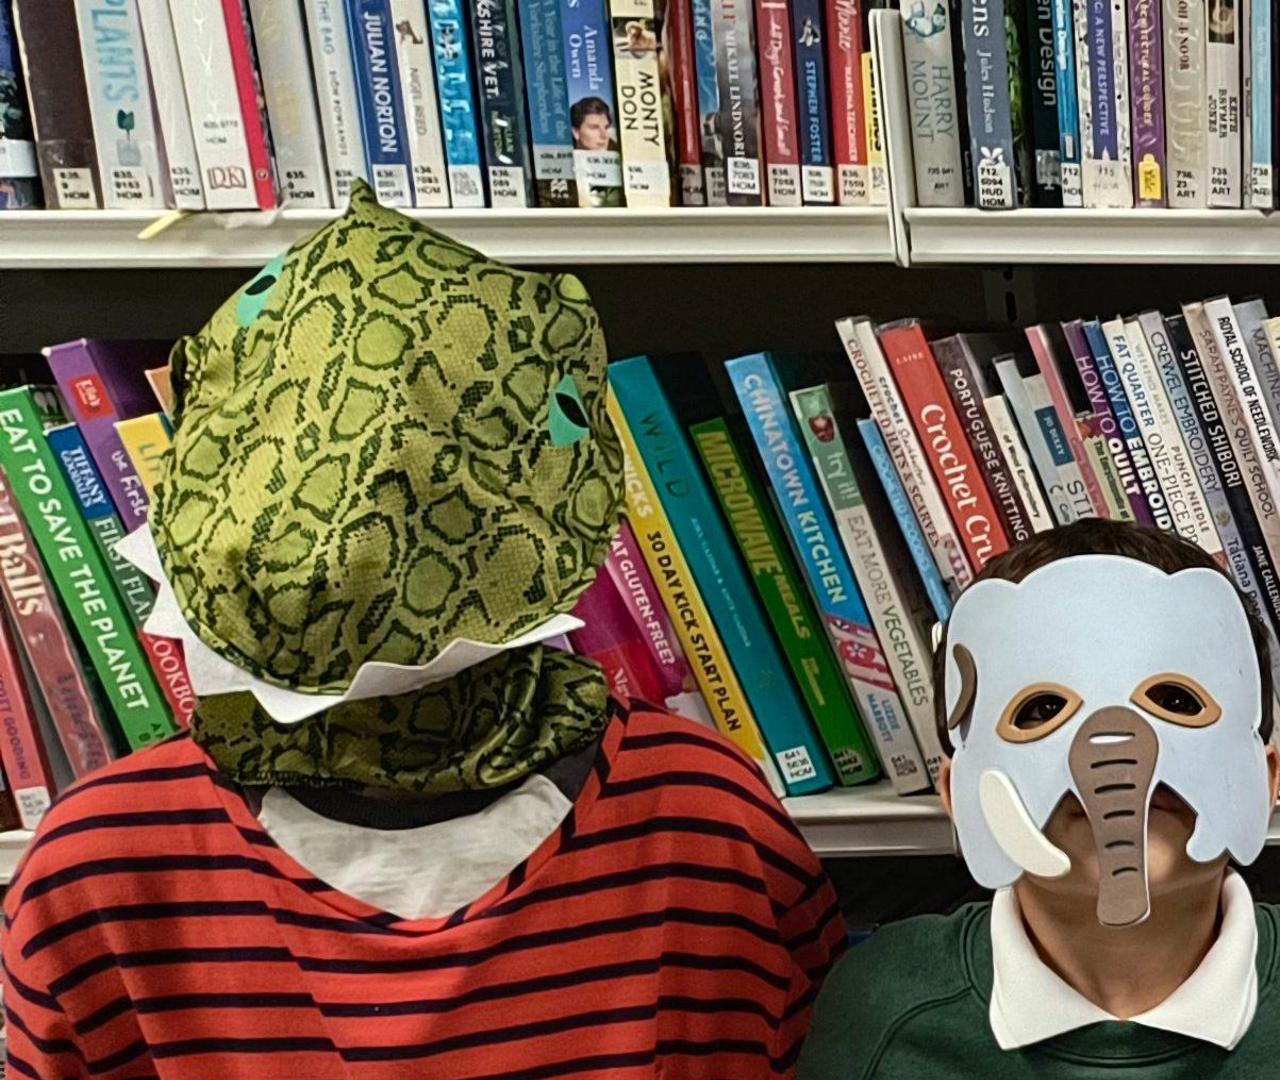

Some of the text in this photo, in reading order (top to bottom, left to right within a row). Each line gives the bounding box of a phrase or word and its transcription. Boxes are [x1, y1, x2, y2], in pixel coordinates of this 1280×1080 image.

[362, 10, 400, 155] JULIAN NORTON
[623, 84, 640, 132] DON
[638, 70, 661, 148] MONTY
[743, 374, 806, 508] CHINATOWN
[798, 509, 848, 604] KITCHEN
[1182, 349, 1243, 487] STITCHED SHIBORI
[1, 409, 150, 711] EAT TO SAVE THE PLANET
[647, 530, 742, 732] 30 DAY KICK START PLAN
